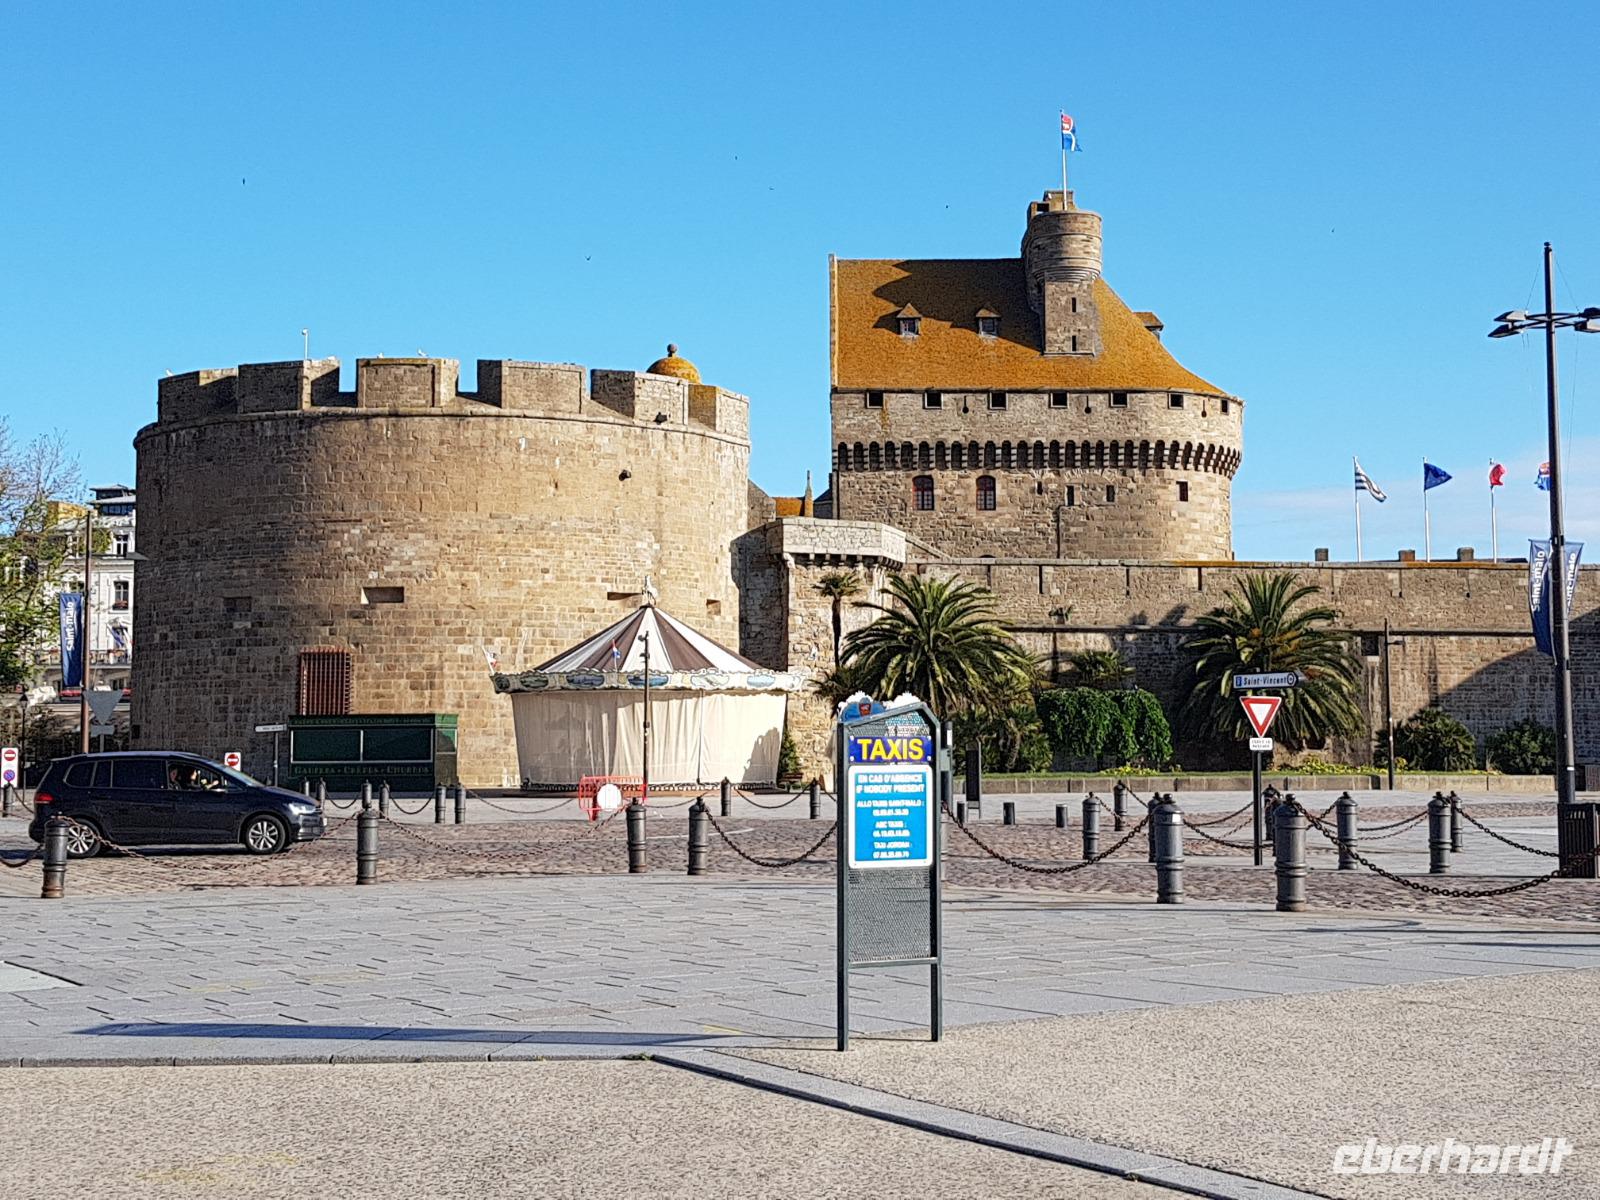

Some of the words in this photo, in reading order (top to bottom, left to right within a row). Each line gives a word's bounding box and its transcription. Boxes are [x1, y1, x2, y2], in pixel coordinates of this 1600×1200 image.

[1243, 675, 1287, 685] Saint-Vincent
[857, 738, 923, 760] TAXIS
[869, 774, 883, 783] CAS
